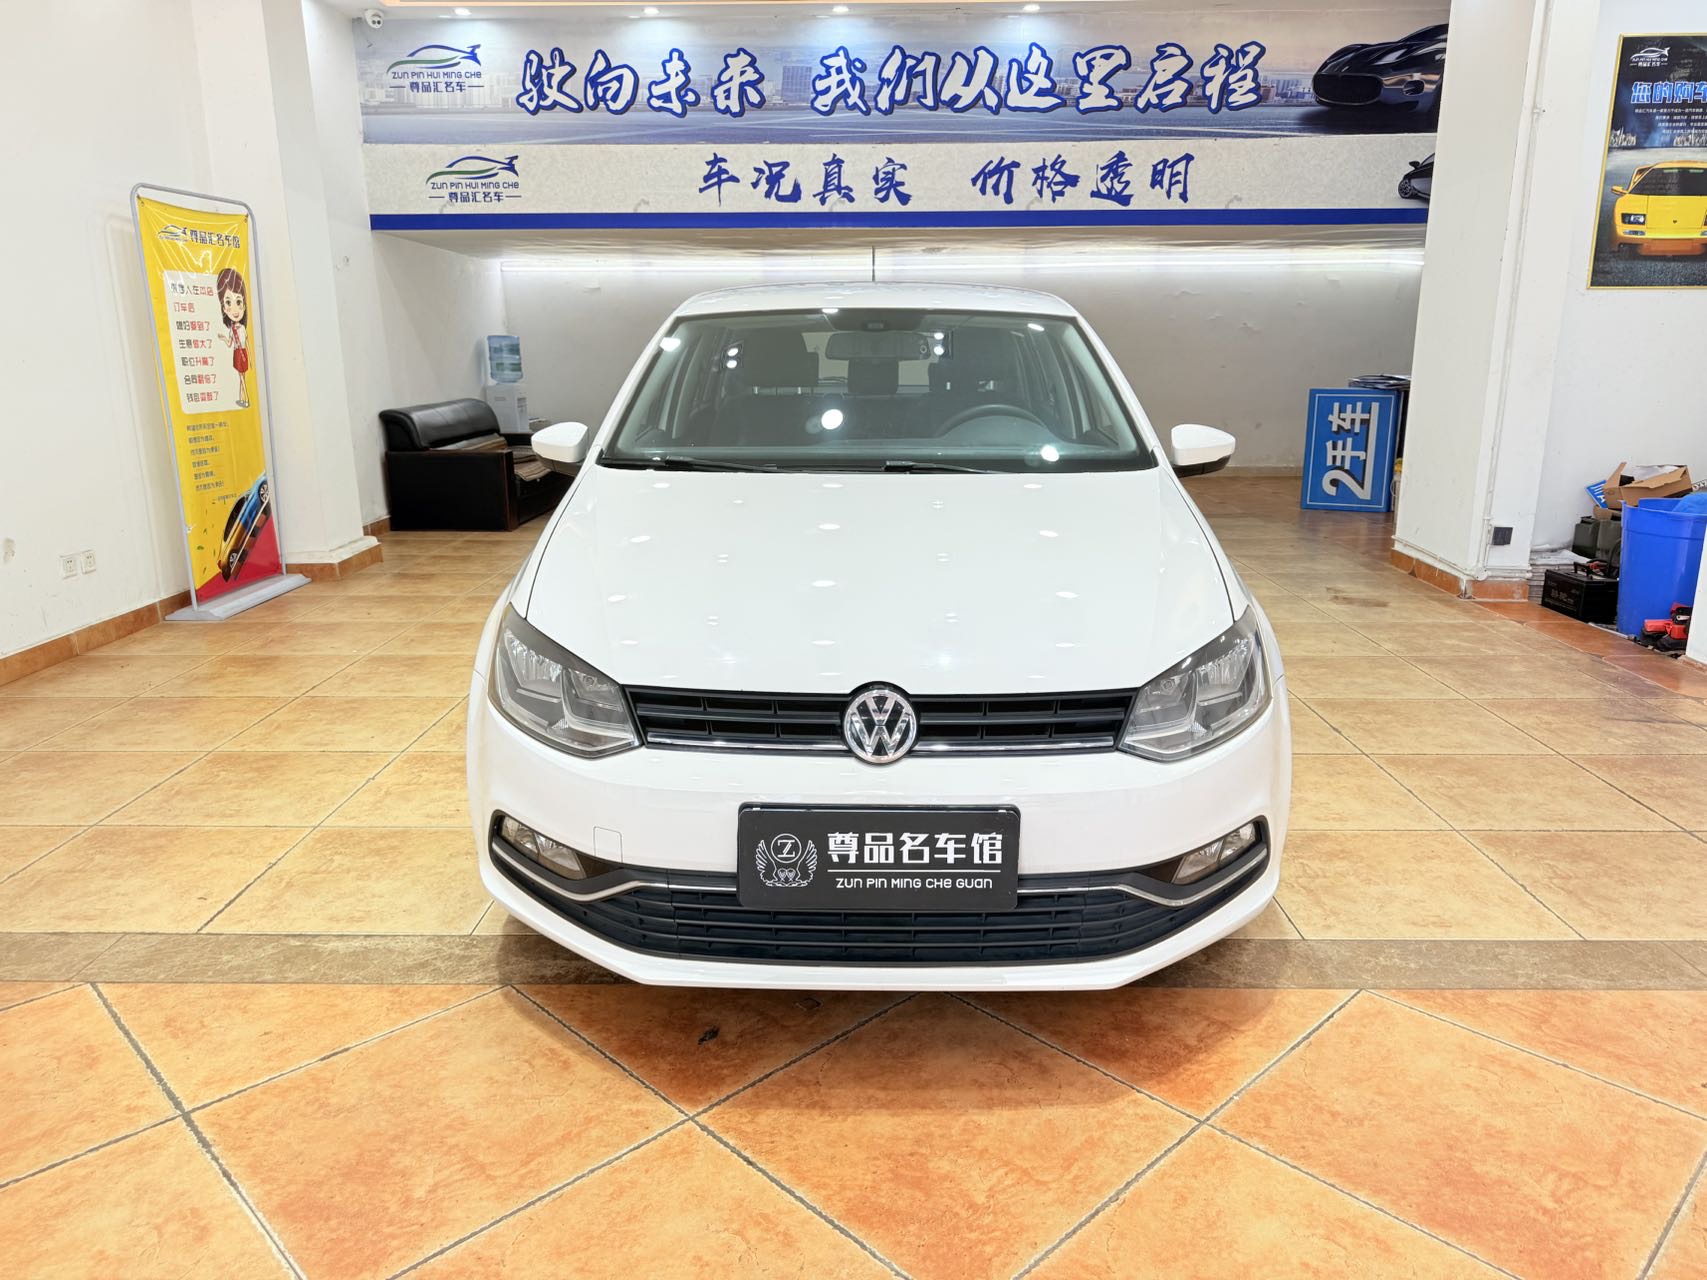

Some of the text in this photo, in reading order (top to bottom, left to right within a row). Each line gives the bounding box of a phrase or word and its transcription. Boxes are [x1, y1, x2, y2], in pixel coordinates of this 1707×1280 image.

[409, 81, 466, 93] 尊品汇名车
[516, 41, 1267, 117] 驶向未来 我们从这里启程
[448, 191, 504, 203] 尊品汇名车
[699, 149, 1196, 206] 车况真实 价格透明
[1322, 401, 1379, 500] 2手车
[827, 831, 1003, 864] 尊品名车馆
